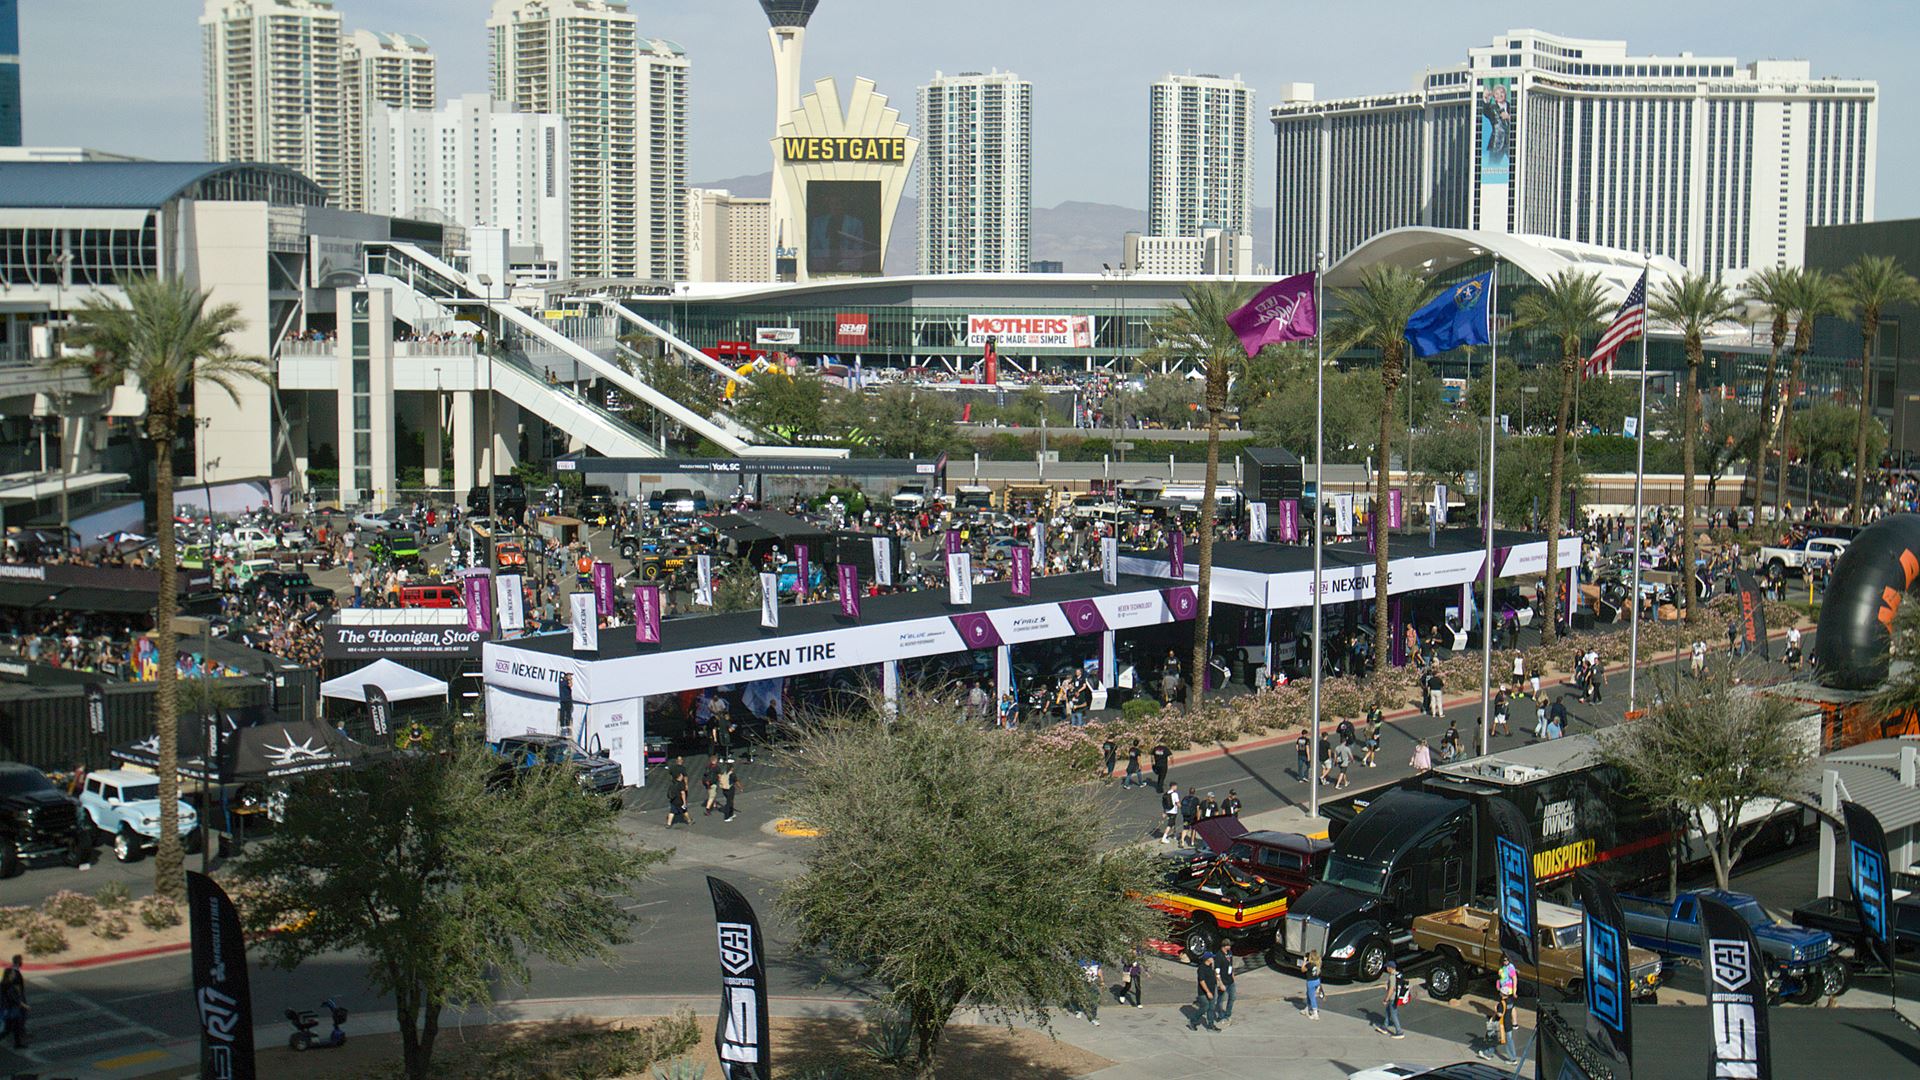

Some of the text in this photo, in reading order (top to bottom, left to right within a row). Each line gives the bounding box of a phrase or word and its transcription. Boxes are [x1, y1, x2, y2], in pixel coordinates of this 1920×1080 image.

[785, 139, 904, 160] WESTGATE
[692, 190, 700, 251] SAHARA
[839, 323, 867, 332] SEMA
[971, 318, 1068, 333] MOTHERS
[971, 335, 1004, 344] CERIC
[1006, 335, 1027, 344] MADE
[1040, 335, 1068, 344] SIMPLE
[712, 462, 730, 471] York,
[729, 463, 740, 471] SC
[1332, 572, 1393, 593] NEXEN TE
[338, 629, 480, 646] The Hoonigan Store
[729, 649, 790, 673] NEXEN
[796, 642, 836, 663] TIRE
[511, 662, 545, 680] NEXEN
[549, 669, 574, 683] TIR
[1542, 812, 1575, 836] OWNED
[1533, 838, 1597, 879] NDISPUTED.
